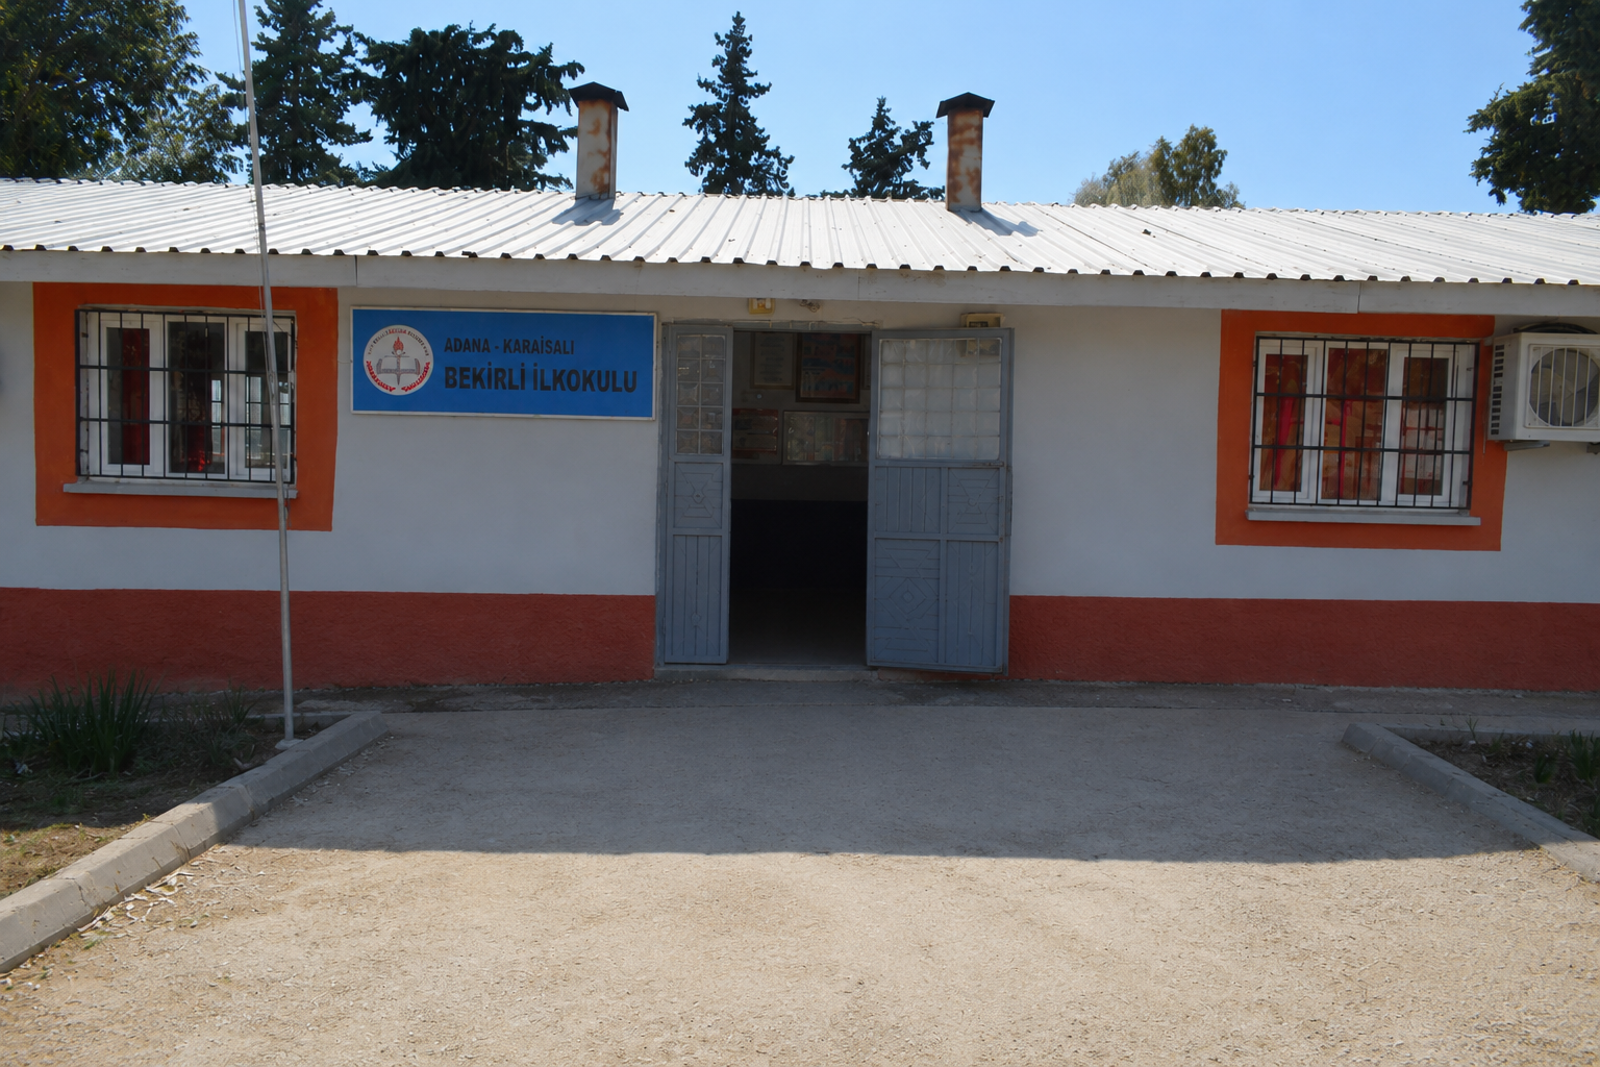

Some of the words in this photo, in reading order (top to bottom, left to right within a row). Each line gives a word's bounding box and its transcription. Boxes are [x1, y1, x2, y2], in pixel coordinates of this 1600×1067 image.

[444, 338, 491, 353] ADANA
[503, 335, 574, 355] KARAİSALI
[444, 361, 525, 391] BEKİRLİ
[533, 362, 638, 393] İLKOKULU
